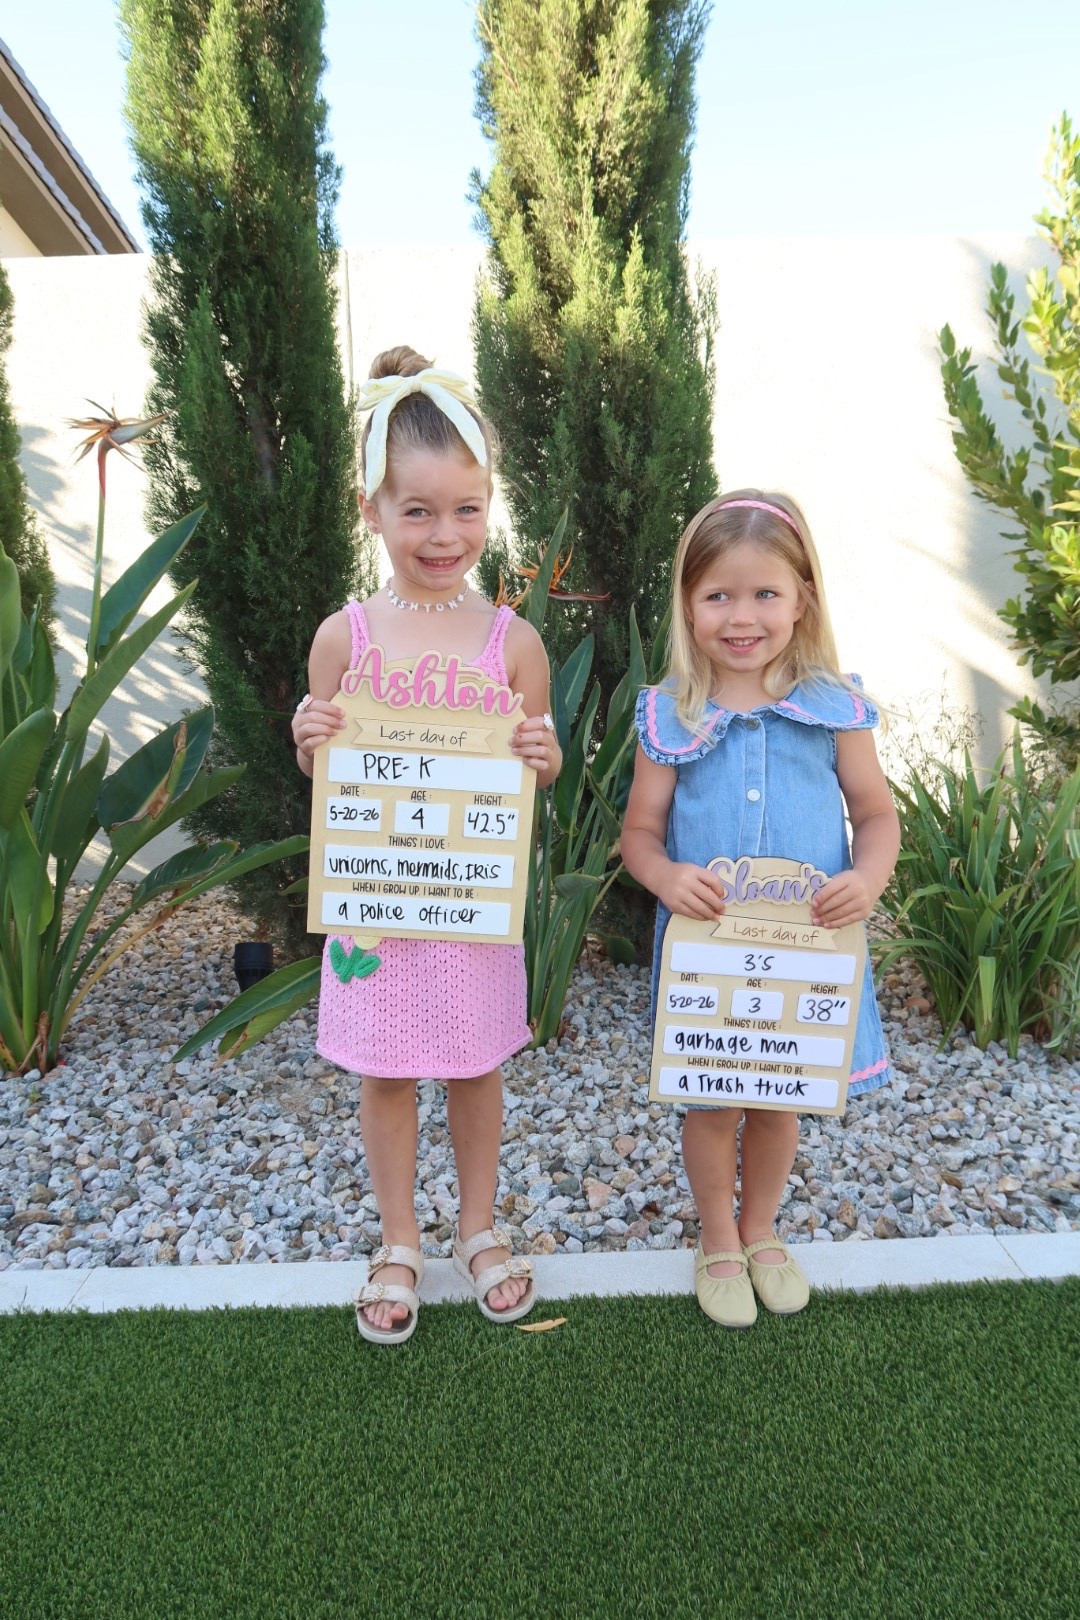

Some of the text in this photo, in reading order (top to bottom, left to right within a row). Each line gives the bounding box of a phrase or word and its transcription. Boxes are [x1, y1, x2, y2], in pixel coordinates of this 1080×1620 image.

[390, 596, 458, 612] ASHTON
[344, 647, 520, 715] Ashton
[380, 725, 467, 747] Last day of
[419, 756, 435, 780] K
[330, 805, 380, 821] 5-20-26
[411, 807, 425, 830] 4
[467, 811, 515, 835] 42.5"
[388, 835, 418, 848] THINGS
[352, 882, 376, 893] WHEN
[383, 883, 407, 894] GROW
[428, 886, 451, 898] WANT
[453, 887, 463, 898] TO
[338, 902, 482, 926] a police officer
[733, 921, 819, 945] Last day of
[669, 994, 715, 1009] 5-20-26
[748, 997, 762, 1013] 3
[802, 998, 846, 1022] 38"
[723, 1017, 750, 1029] THINGS
[675, 1031, 798, 1056] garbage man
[687, 1056, 710, 1067] WHEN
[716, 1058, 739, 1069] GROW
[759, 1062, 781, 1073] WANT
[783, 1064, 793, 1075] TO
[679, 1074, 689, 1092] a
[754, 1077, 809, 1097] truck
